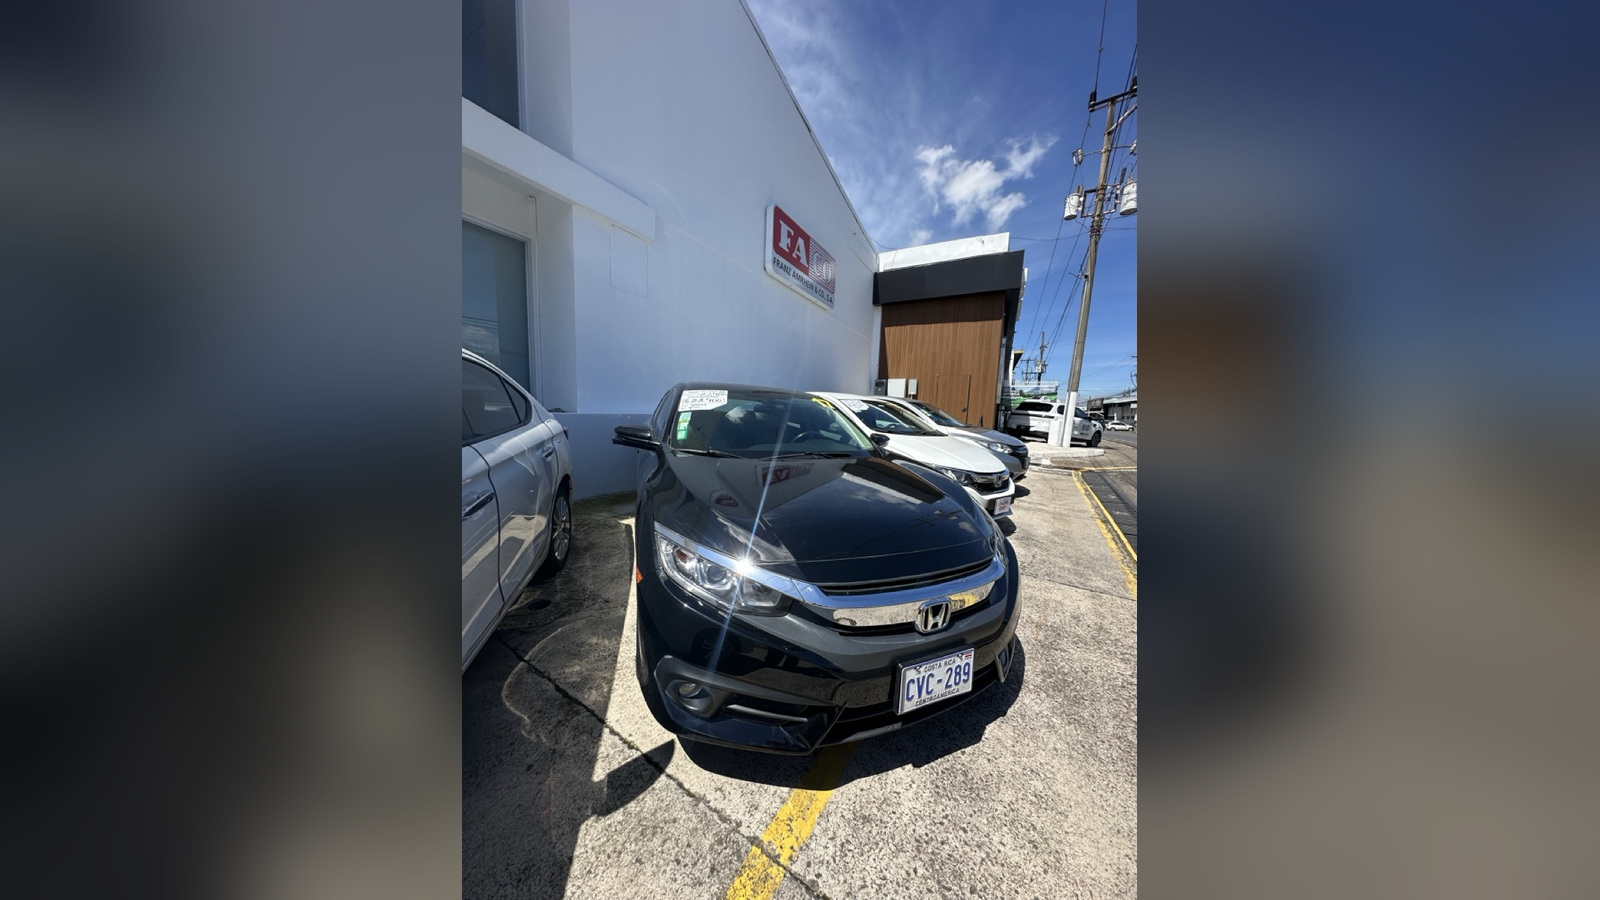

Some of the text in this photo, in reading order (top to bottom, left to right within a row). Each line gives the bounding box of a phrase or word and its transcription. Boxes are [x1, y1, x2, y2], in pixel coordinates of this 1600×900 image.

[773, 257, 792, 276] FRANZ
[792, 271, 814, 291] AMRHEIN
[924, 658, 956, 673] COSTA RICA
[906, 662, 971, 702] CVC-289
[915, 688, 960, 706] CENTROAMERICA
